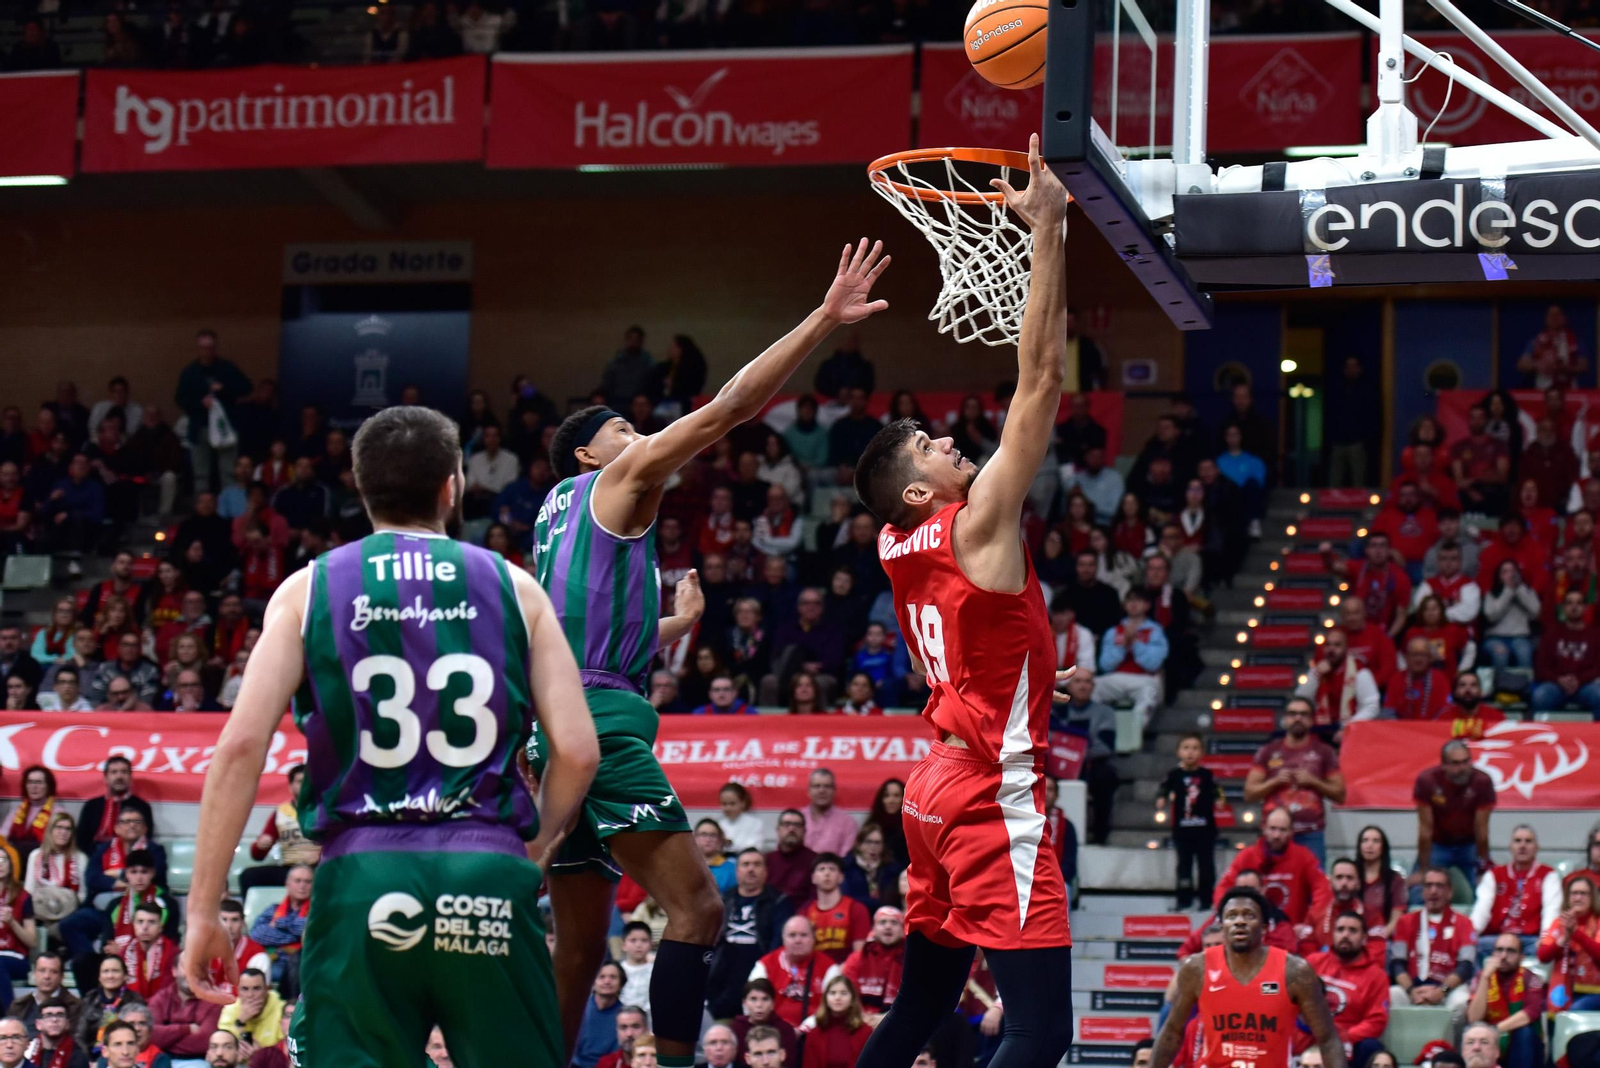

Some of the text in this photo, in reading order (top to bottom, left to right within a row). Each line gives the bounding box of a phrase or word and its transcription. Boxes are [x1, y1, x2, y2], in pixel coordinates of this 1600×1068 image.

[983, 18, 1023, 42] endesa
[175, 75, 455, 147] patrimonial
[291, 250, 464, 274] Grada Norte
[535, 488, 576, 527] aylor
[368, 551, 457, 582] Tillie
[906, 603, 951, 685] 19
[351, 652, 499, 769] 33
[773, 741, 800, 754] DE
[802, 735, 931, 761] LEVAN
[435, 894, 513, 920] COSTA
[434, 917, 512, 939] DEL SOL
[433, 935, 510, 957] MÁLAGA
[1212, 1012, 1278, 1033] UCAM
[1221, 1031, 1267, 1043] MURCIA
